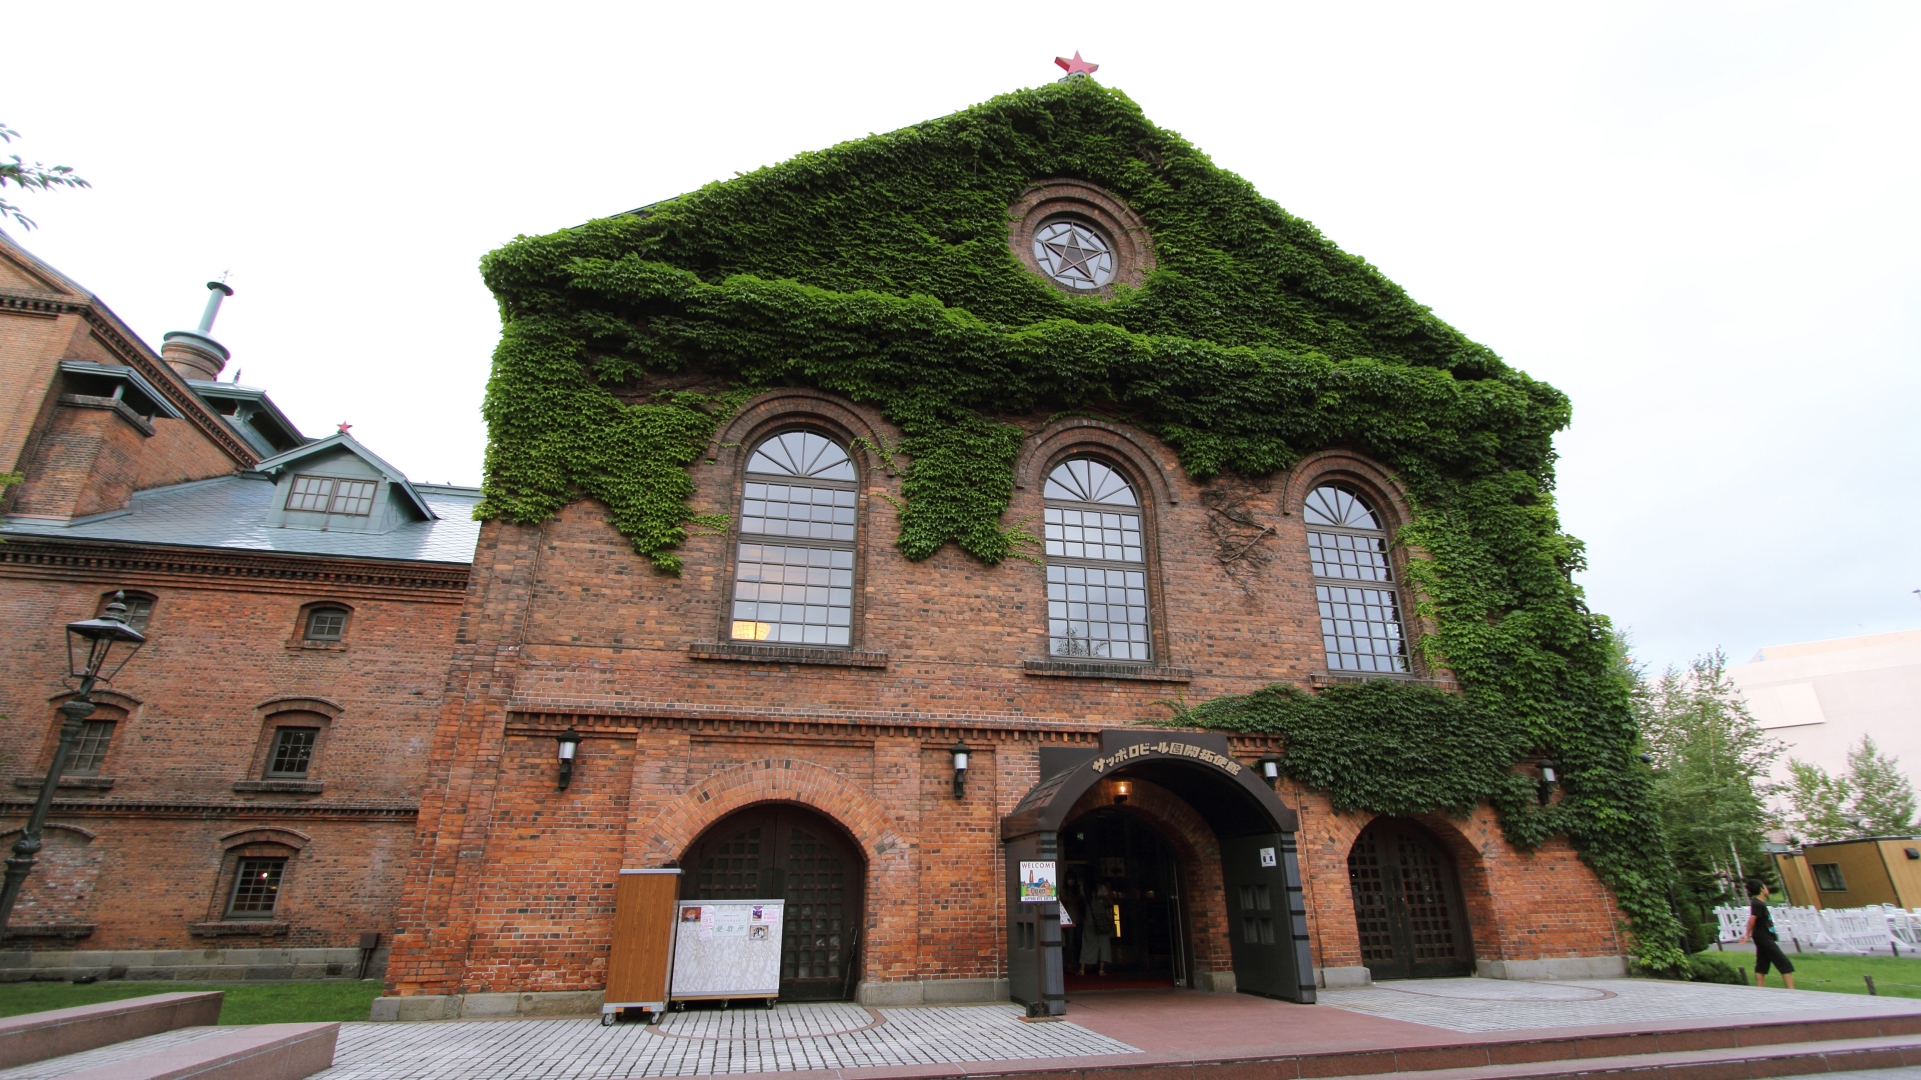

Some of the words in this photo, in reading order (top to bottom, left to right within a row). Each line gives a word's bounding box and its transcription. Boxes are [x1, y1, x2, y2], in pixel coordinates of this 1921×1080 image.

[1092, 741, 1242, 776] サッポロビール園開拓使館
